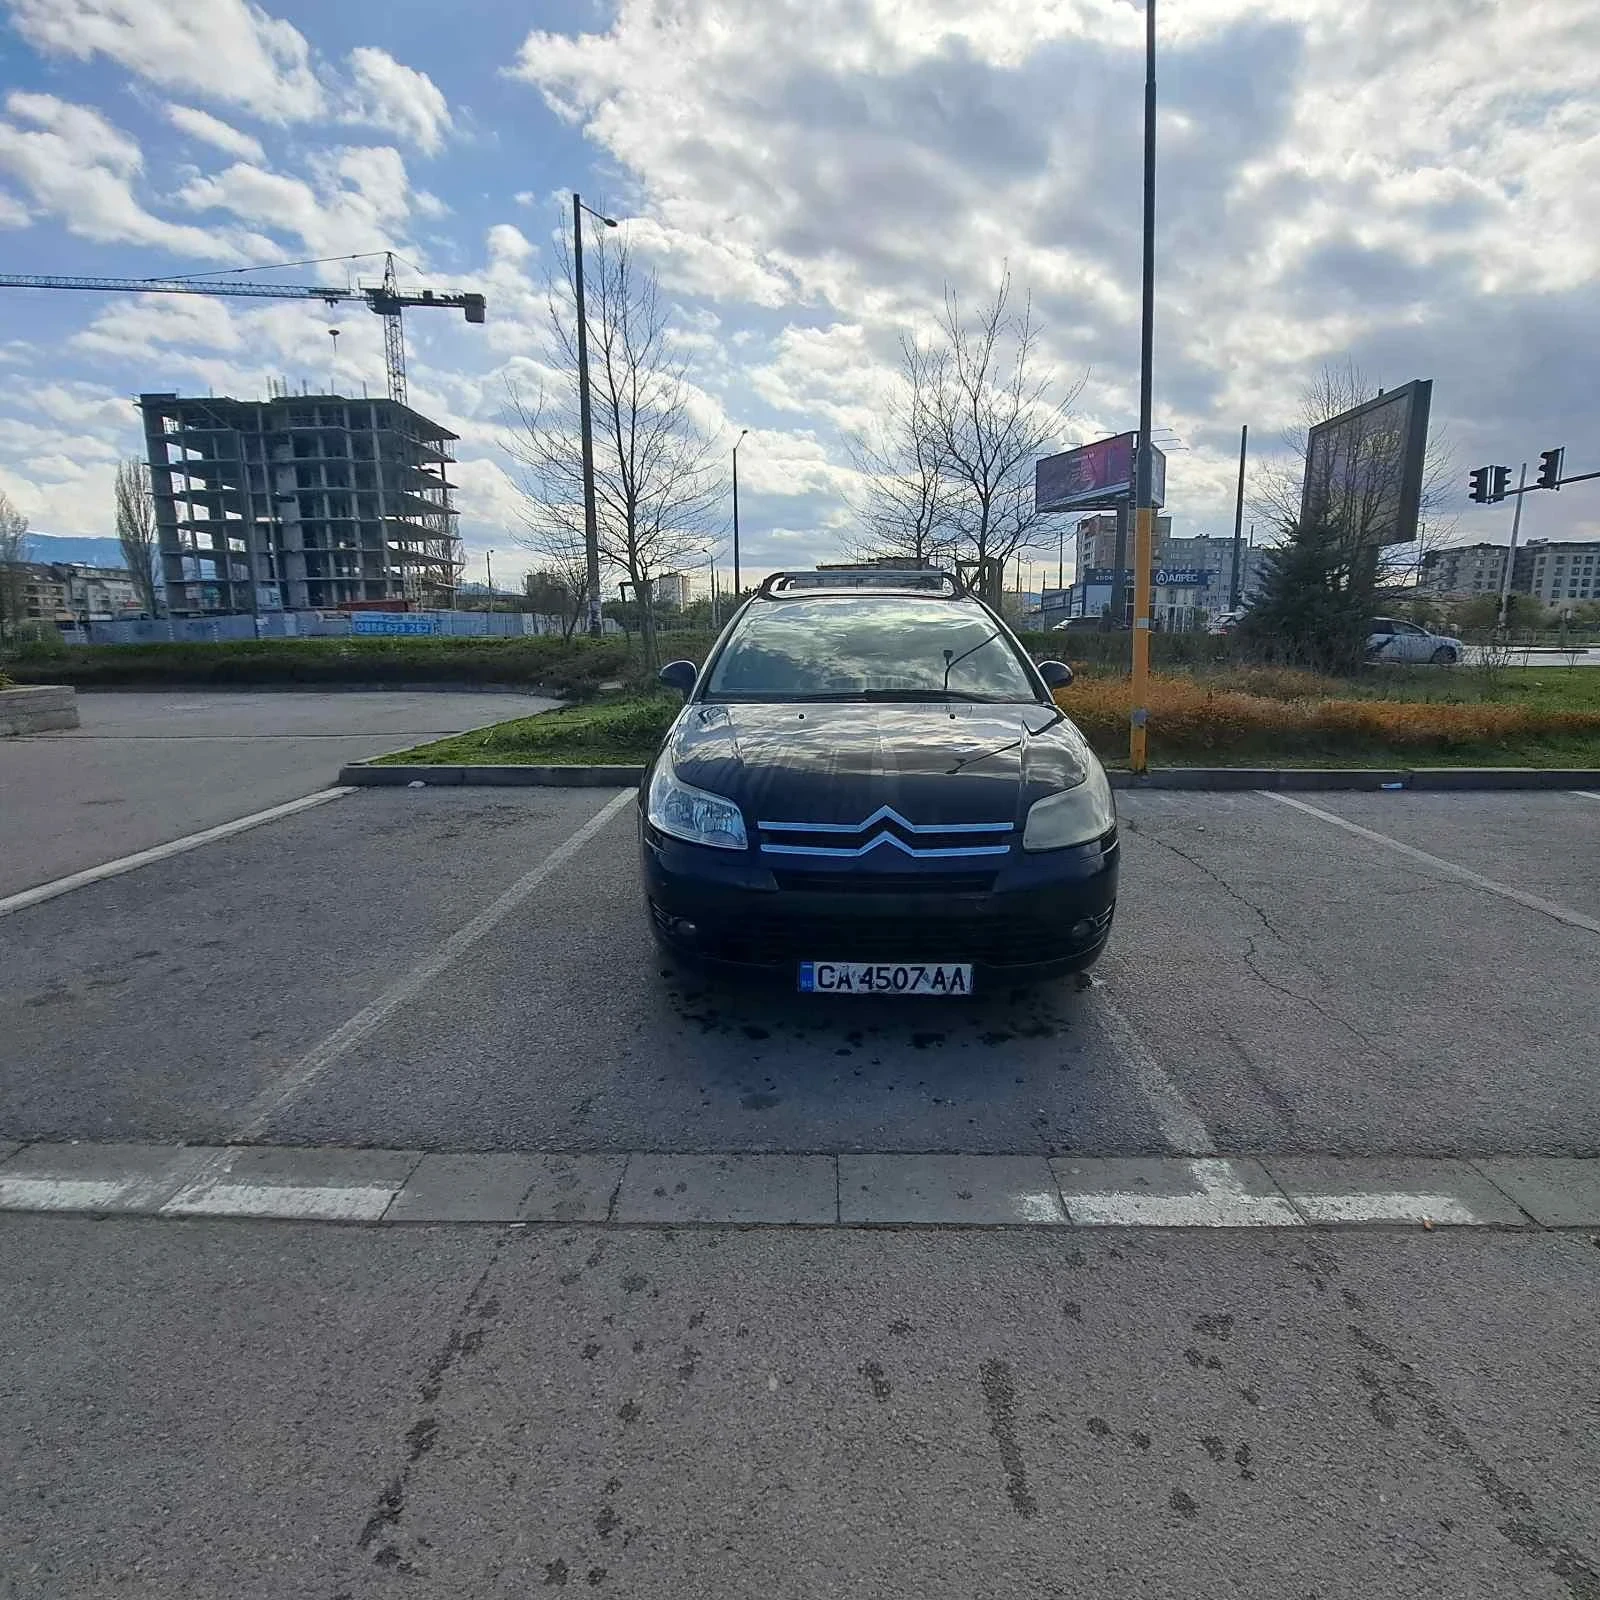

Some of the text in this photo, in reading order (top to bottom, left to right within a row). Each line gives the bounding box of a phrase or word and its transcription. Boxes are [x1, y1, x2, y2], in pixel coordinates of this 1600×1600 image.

[817, 964, 966, 992] CA 4507 AA
